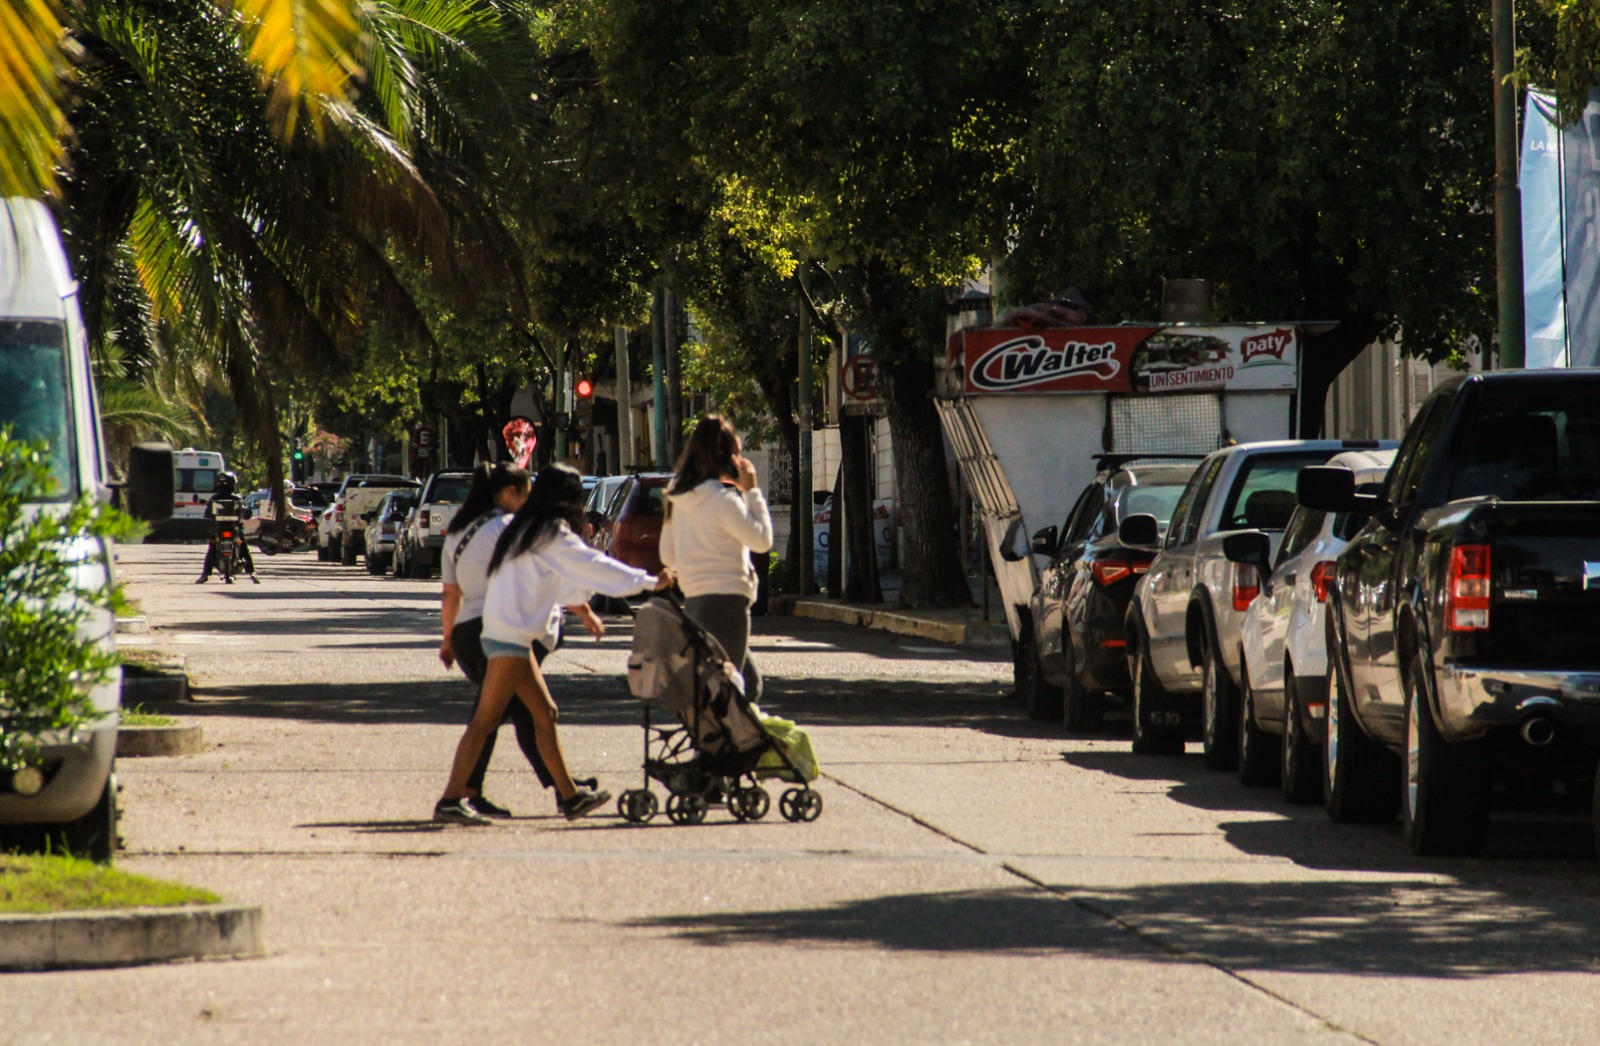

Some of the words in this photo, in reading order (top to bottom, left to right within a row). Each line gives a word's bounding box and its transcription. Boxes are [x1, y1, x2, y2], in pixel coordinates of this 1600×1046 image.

[1530, 140, 1545, 150] LA
[1246, 335, 1285, 356] paty
[1001, 342, 1116, 381] Walter
[1151, 374, 1166, 388] UN
[1168, 366, 1234, 386] SENTIMIENTO
